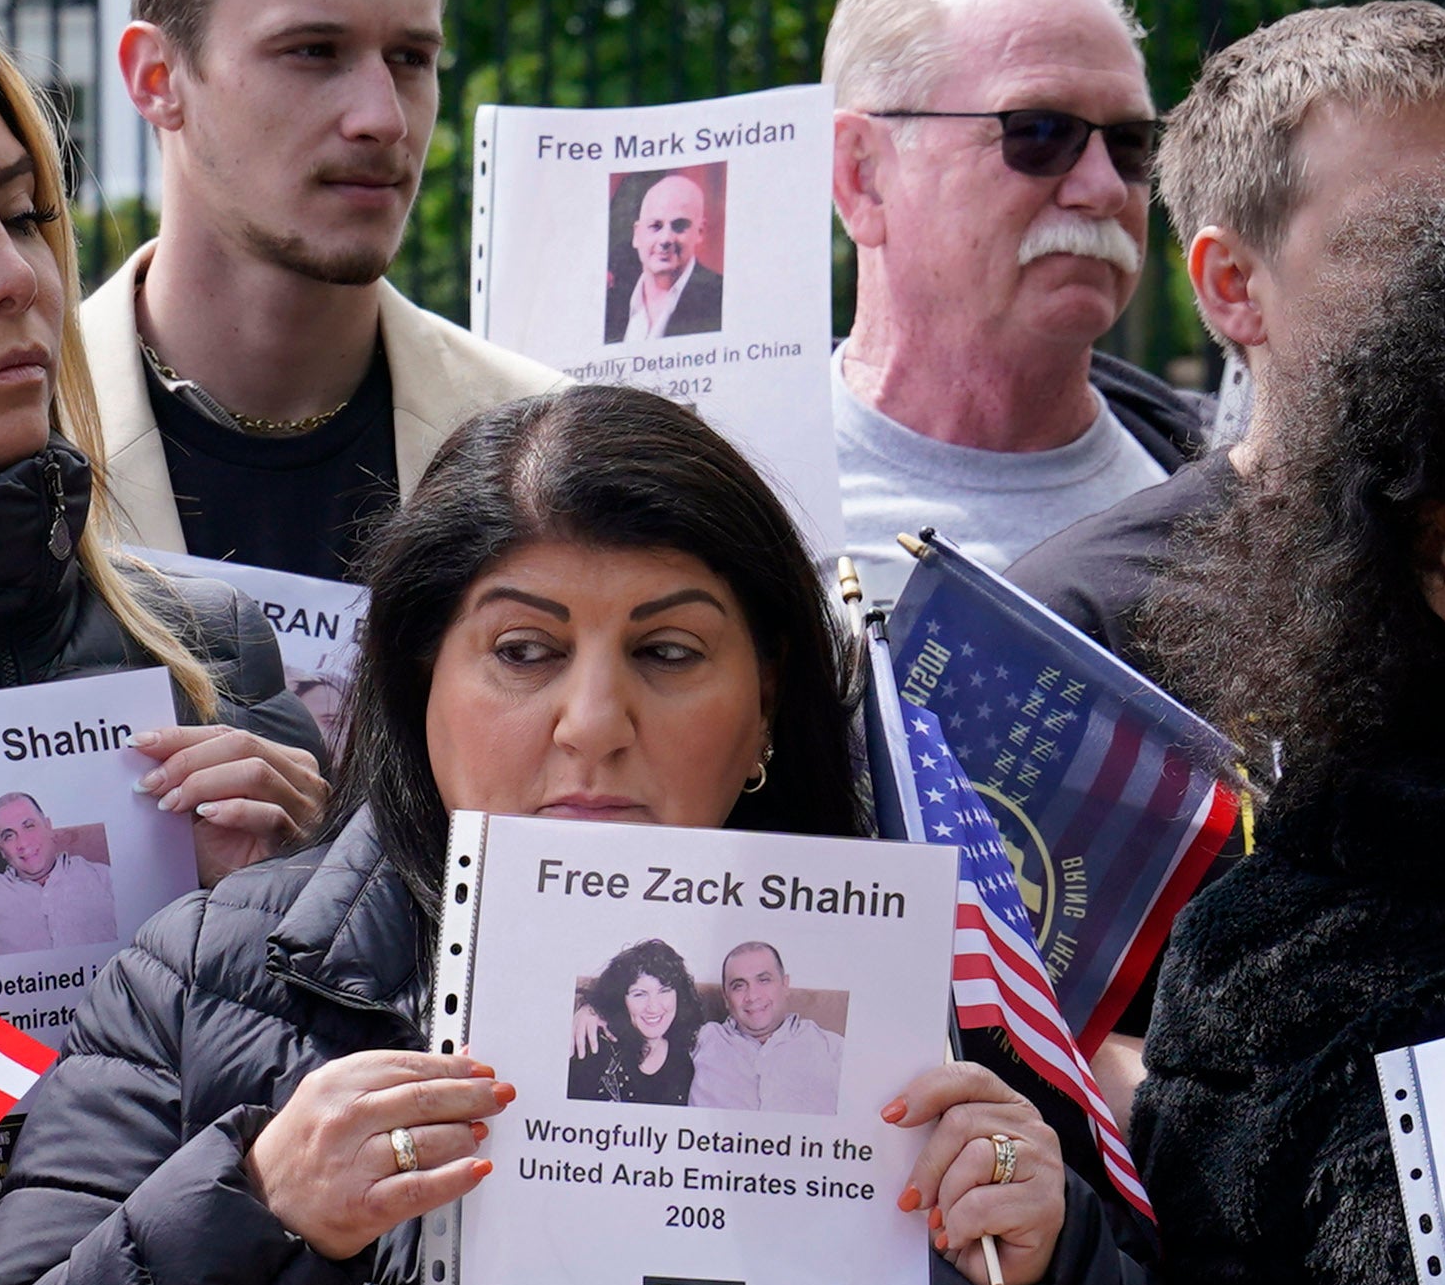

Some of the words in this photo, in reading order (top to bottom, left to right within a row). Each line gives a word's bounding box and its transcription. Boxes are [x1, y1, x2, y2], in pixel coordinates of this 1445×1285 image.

[538, 135, 602, 160] Free
[614, 133, 684, 158] Mark
[695, 122, 796, 151] Swidan
[562, 359, 627, 383] ngfully
[633, 350, 716, 372] Detained
[723, 347, 740, 362] in
[747, 341, 801, 360] China
[668, 378, 712, 396] 2012
[254, 600, 340, 641] RAN
[2, 718, 134, 762] Shahin
[537, 859, 630, 898] Free
[643, 867, 745, 907] Zack
[759, 874, 905, 918] Shahin
[525, 1118, 667, 1154] Wrongfully
[678, 1129, 791, 1156] Detained
[800, 1136, 823, 1158] in
[833, 1139, 873, 1162] the
[519, 1157, 603, 1184] United
[612, 1164, 674, 1188] Arab
[684, 1168, 797, 1196] Emirates
[806, 1177, 875, 1200] since
[665, 1205, 726, 1230] 2008
